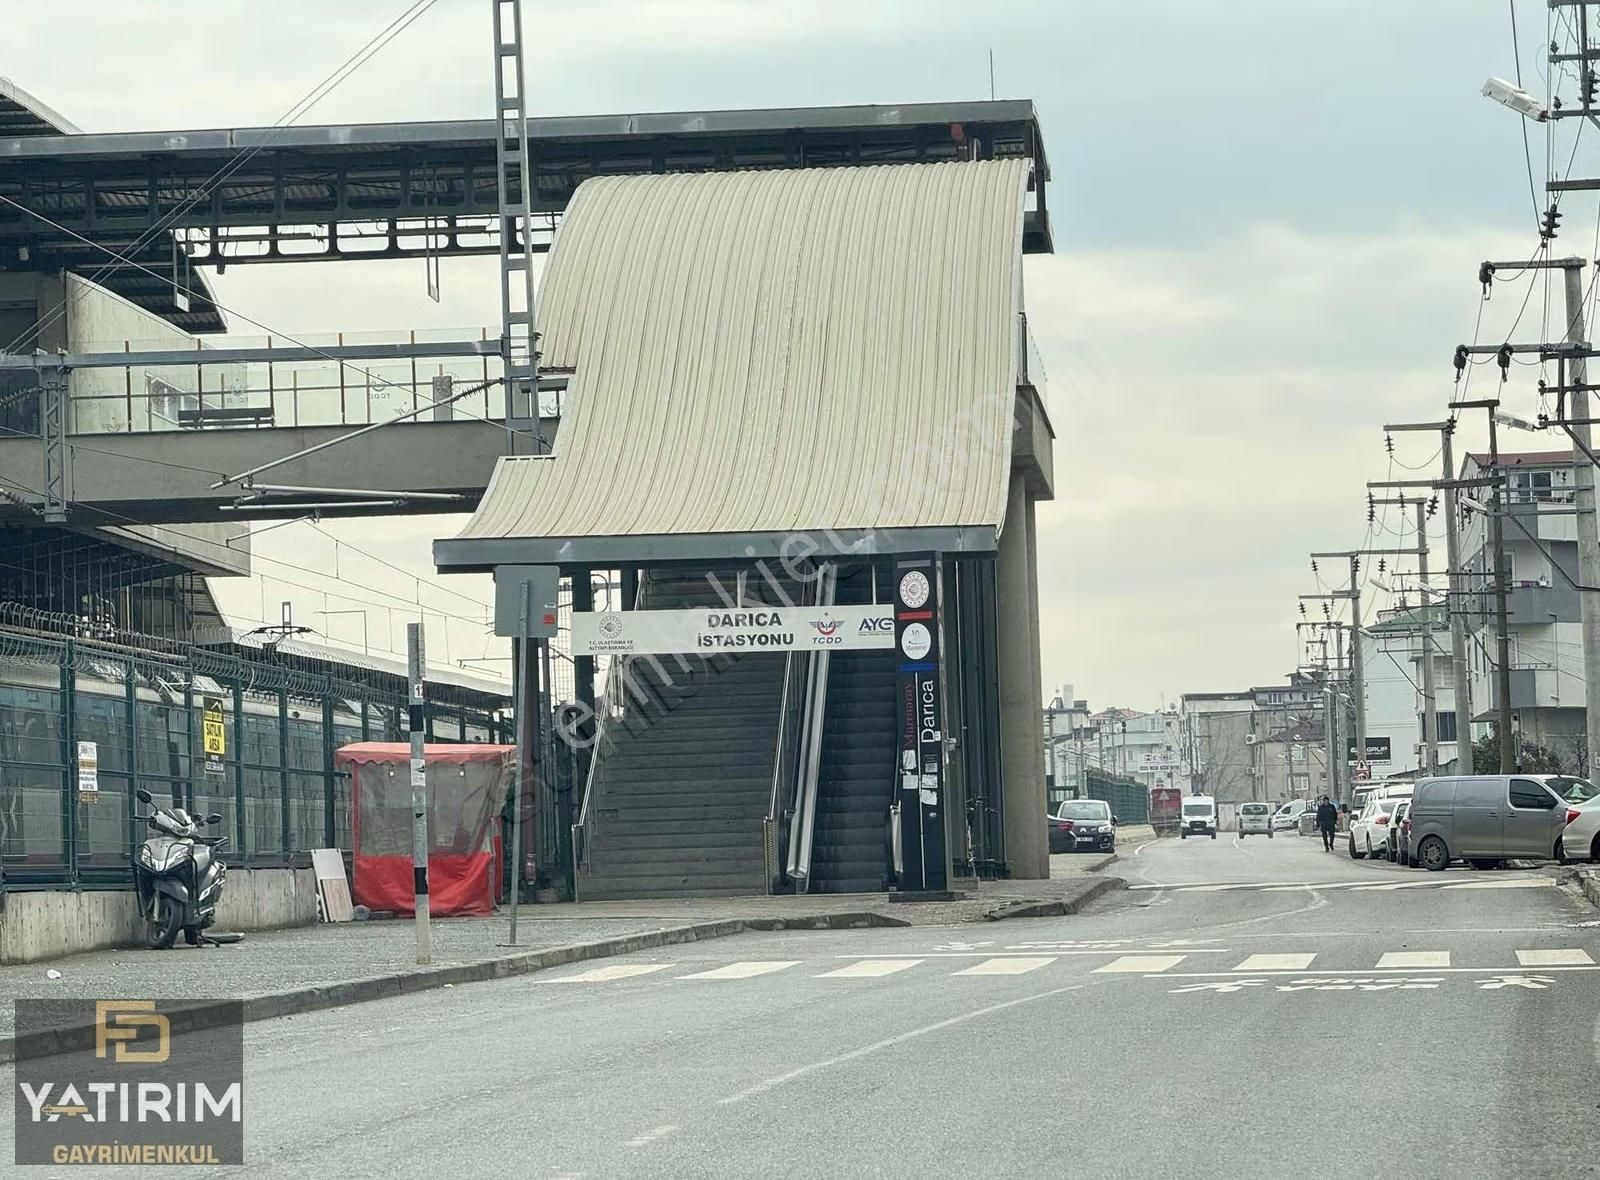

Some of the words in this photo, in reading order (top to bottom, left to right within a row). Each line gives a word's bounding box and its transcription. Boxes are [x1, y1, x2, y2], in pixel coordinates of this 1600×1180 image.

[708, 612, 782, 628] DARICA
[697, 632, 794, 647] İSTASYONU
[811, 636, 842, 645] TCDD
